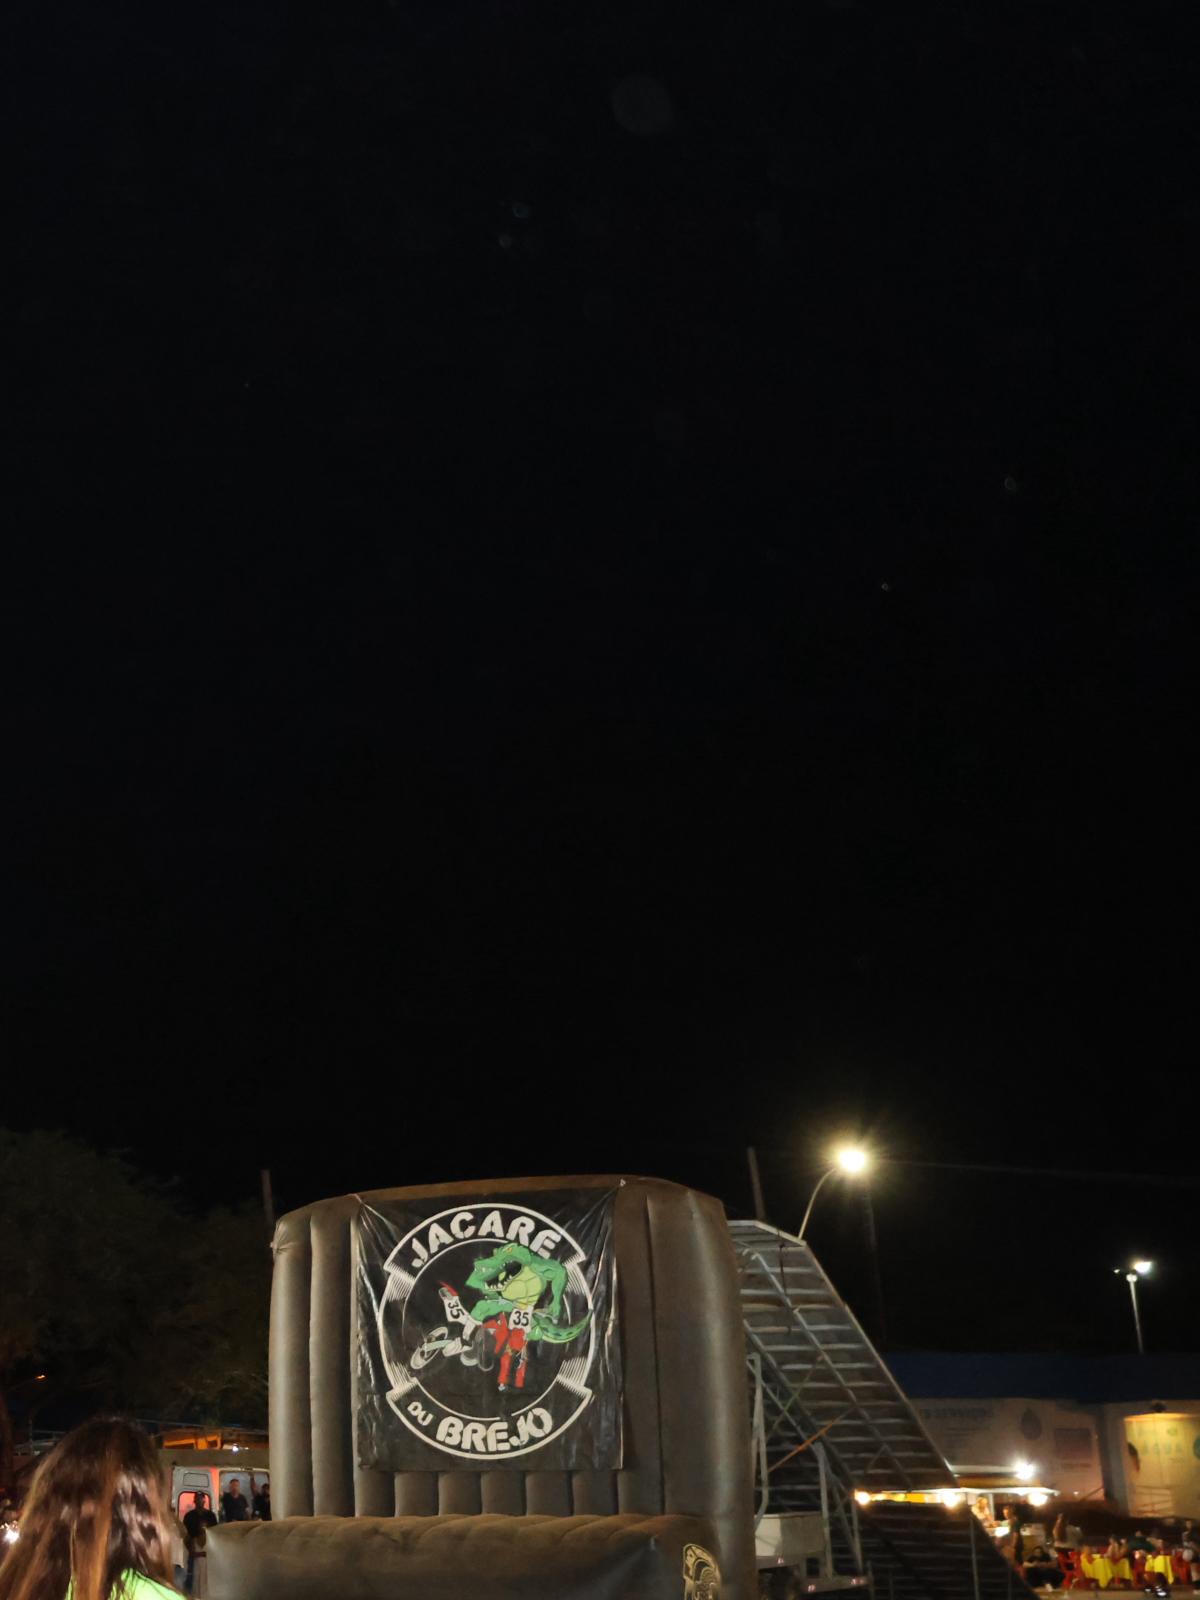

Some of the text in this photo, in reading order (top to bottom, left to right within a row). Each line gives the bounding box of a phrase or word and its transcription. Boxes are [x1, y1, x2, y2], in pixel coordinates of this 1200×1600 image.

[411, 1210, 562, 1268] JACARE
[448, 1301, 465, 1319] 35
[513, 1310, 530, 1327] 35
[407, 1401, 553, 1452] DU BREJO
